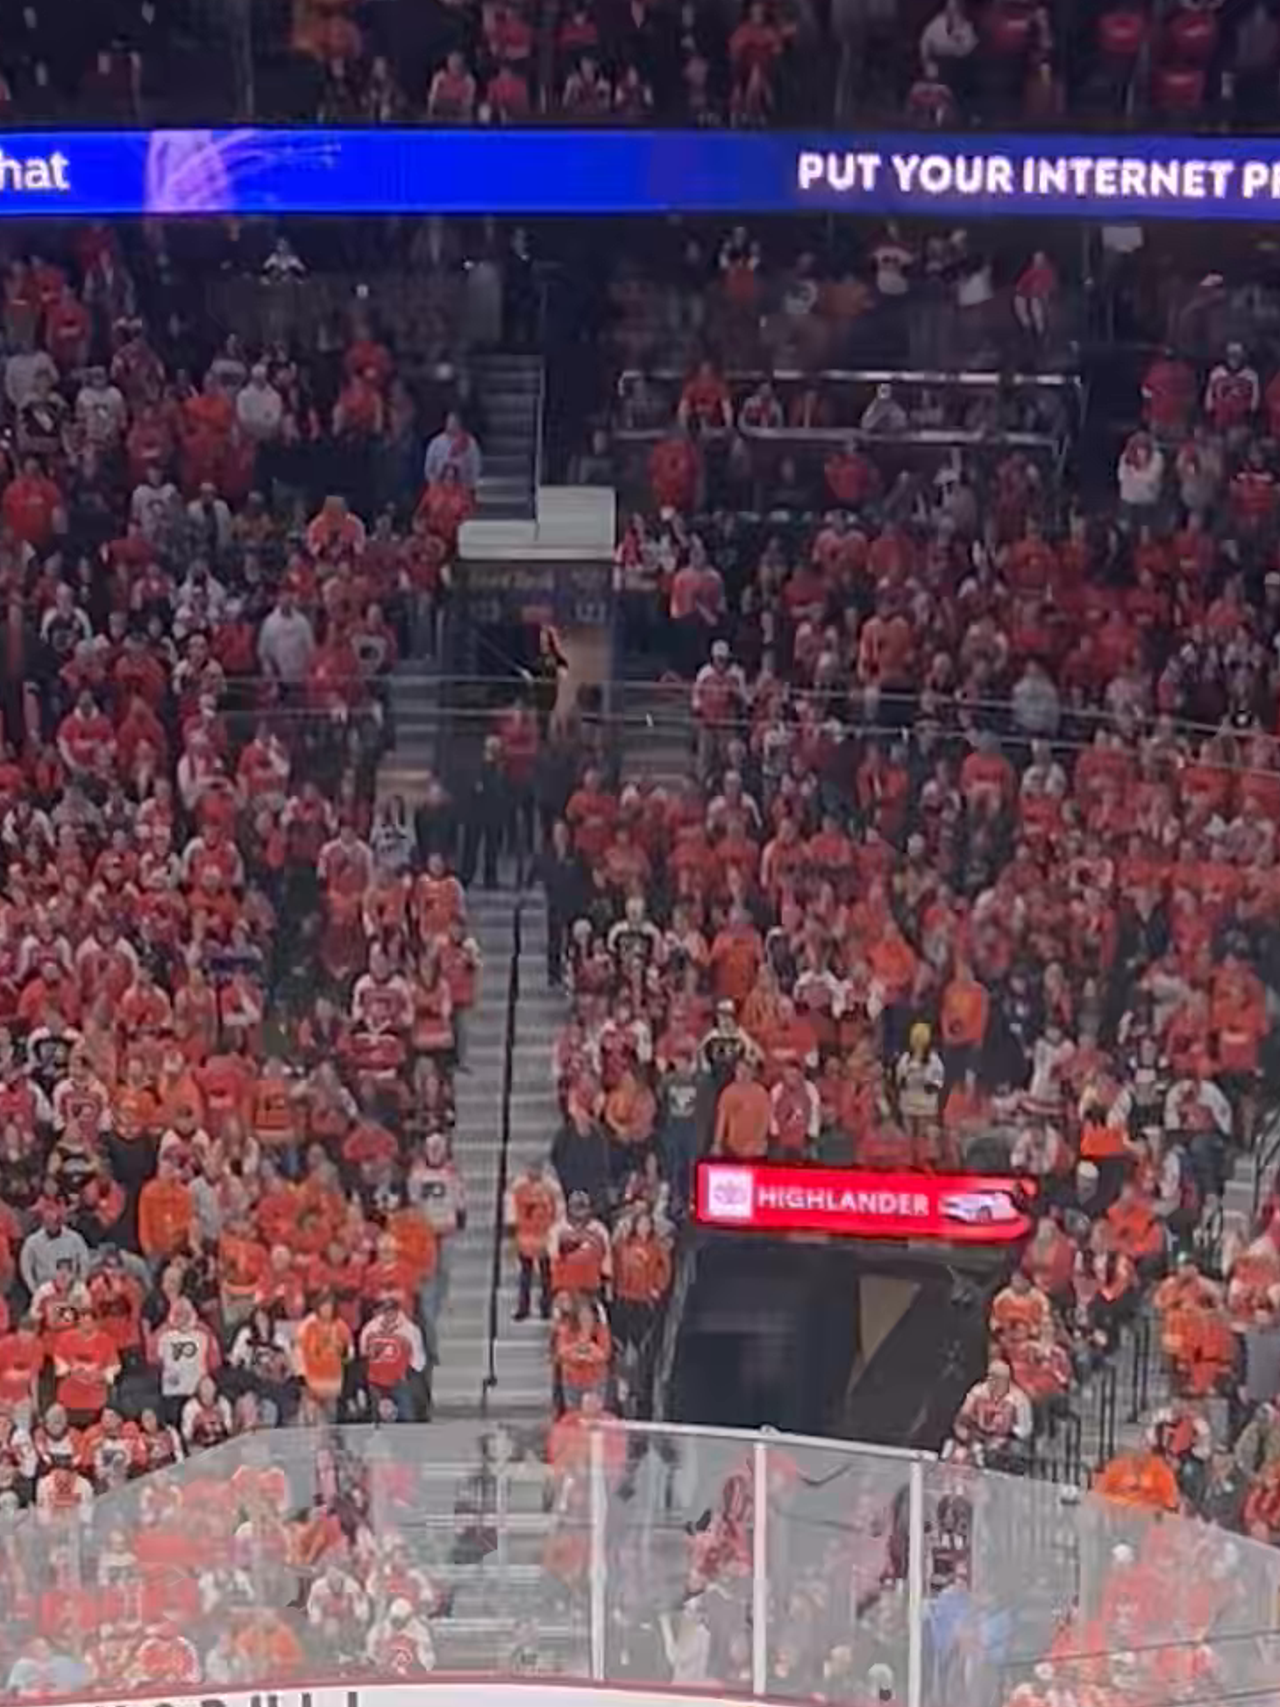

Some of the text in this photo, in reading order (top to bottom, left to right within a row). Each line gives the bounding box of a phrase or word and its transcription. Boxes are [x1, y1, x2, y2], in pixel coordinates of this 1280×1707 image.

[798, 152, 882, 191] PUT
[891, 154, 1015, 194] YOUR
[1022, 156, 1233, 199] INTERNET
[757, 1187, 929, 1216] HIGHLANDER
